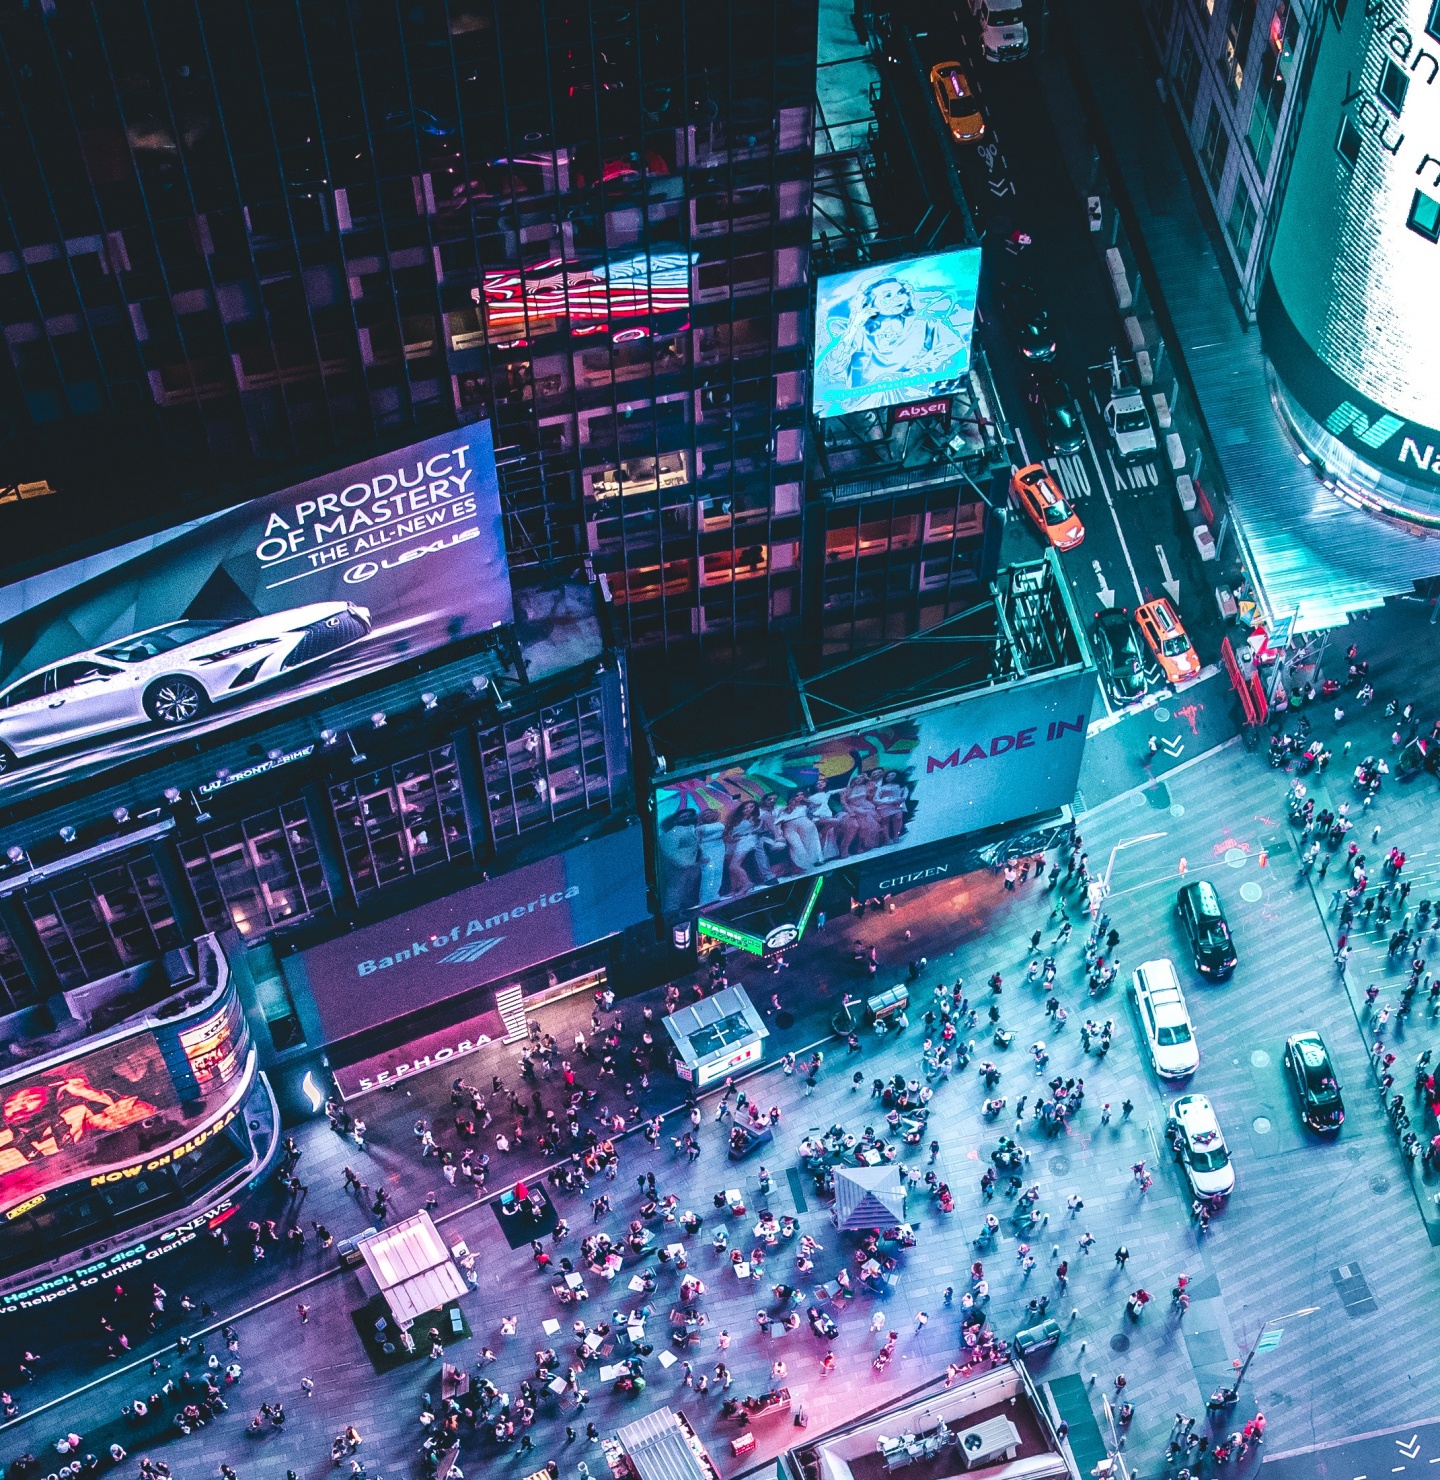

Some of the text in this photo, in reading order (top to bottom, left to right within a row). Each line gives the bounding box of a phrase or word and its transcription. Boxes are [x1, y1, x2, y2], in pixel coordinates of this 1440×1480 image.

[1340, 70, 1405, 157] you
[898, 403, 947, 418] Absen
[264, 444, 470, 537] A PRODUCT
[1041, 454, 1091, 500] ONL
[255, 469, 473, 561] OF MASTERY
[308, 498, 477, 567] THE ALL-NEW ES
[381, 526, 481, 569] LEXUS
[926, 714, 1085, 774] MADE IN
[878, 864, 950, 890] CITIZEN
[357, 885, 580, 978] Bank of America
[359, 1033, 492, 1091] SEPHORA
[91, 1164, 143, 1187] NOW
[146, 1155, 171, 1171] ON
[175, 1198, 232, 1237] NEWS
[19, 1282, 78, 1309] helped
[80, 1275, 98, 1288] to
[101, 1257, 142, 1280] unite
[145, 1232, 197, 1260] Giants
[75, 1261, 107, 1278] has
[110, 1243, 147, 1264] died
